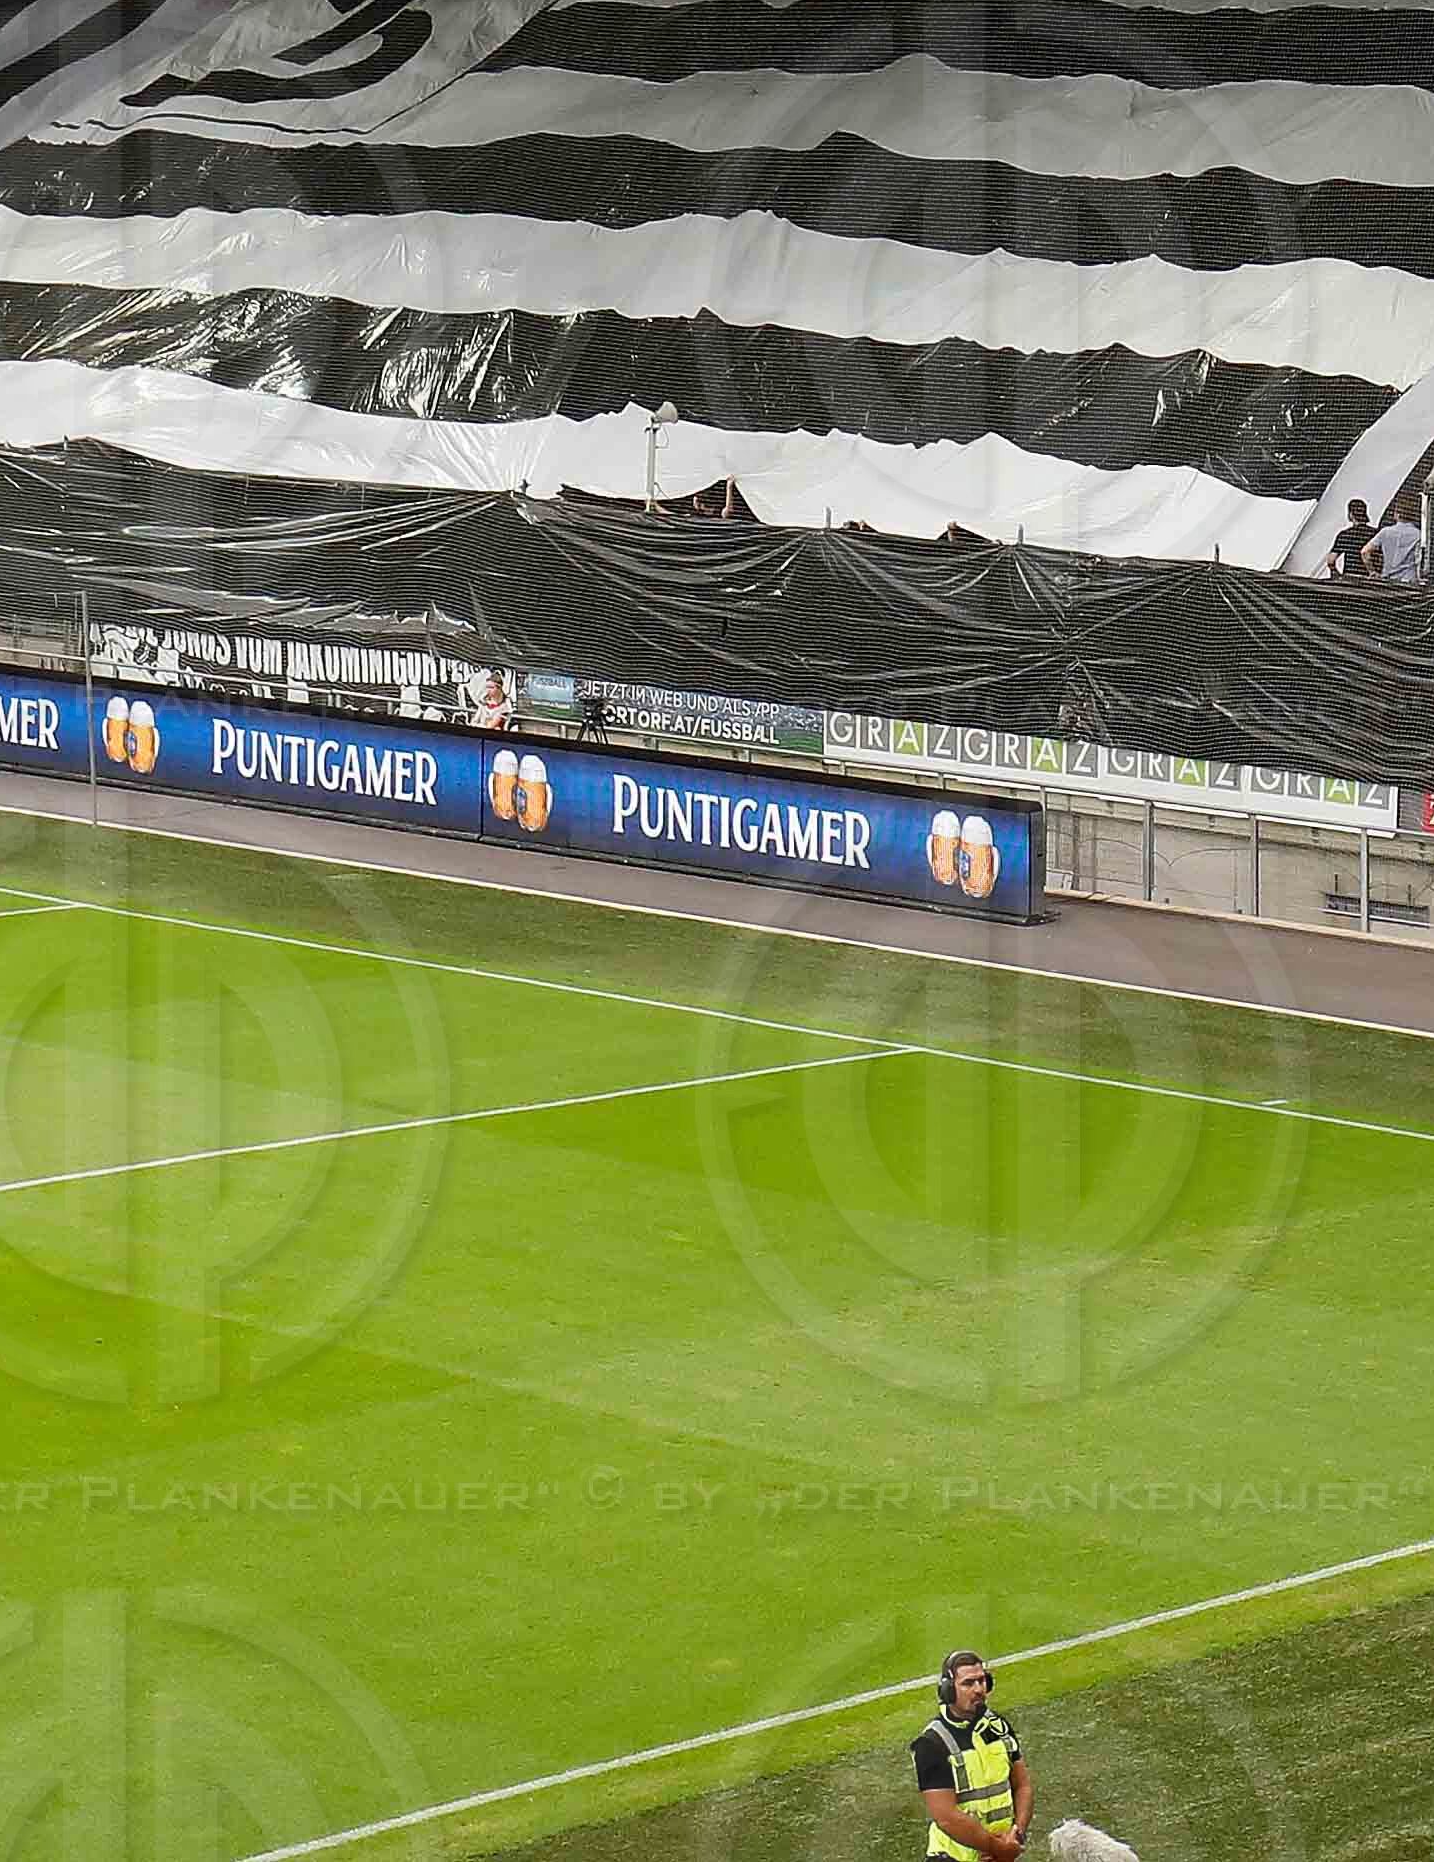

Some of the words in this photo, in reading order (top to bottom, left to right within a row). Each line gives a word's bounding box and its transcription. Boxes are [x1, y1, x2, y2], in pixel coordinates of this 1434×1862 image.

[650, 689, 683, 708] WEB
[687, 694, 718, 712] UND
[722, 698, 751, 716] ALS
[213, 718, 437, 806] PUNTIGAMER
[829, 713, 952, 756] GRAZ
[966, 728, 1091, 772] GRAZ
[613, 774, 871, 869] PUNTIGAMER
